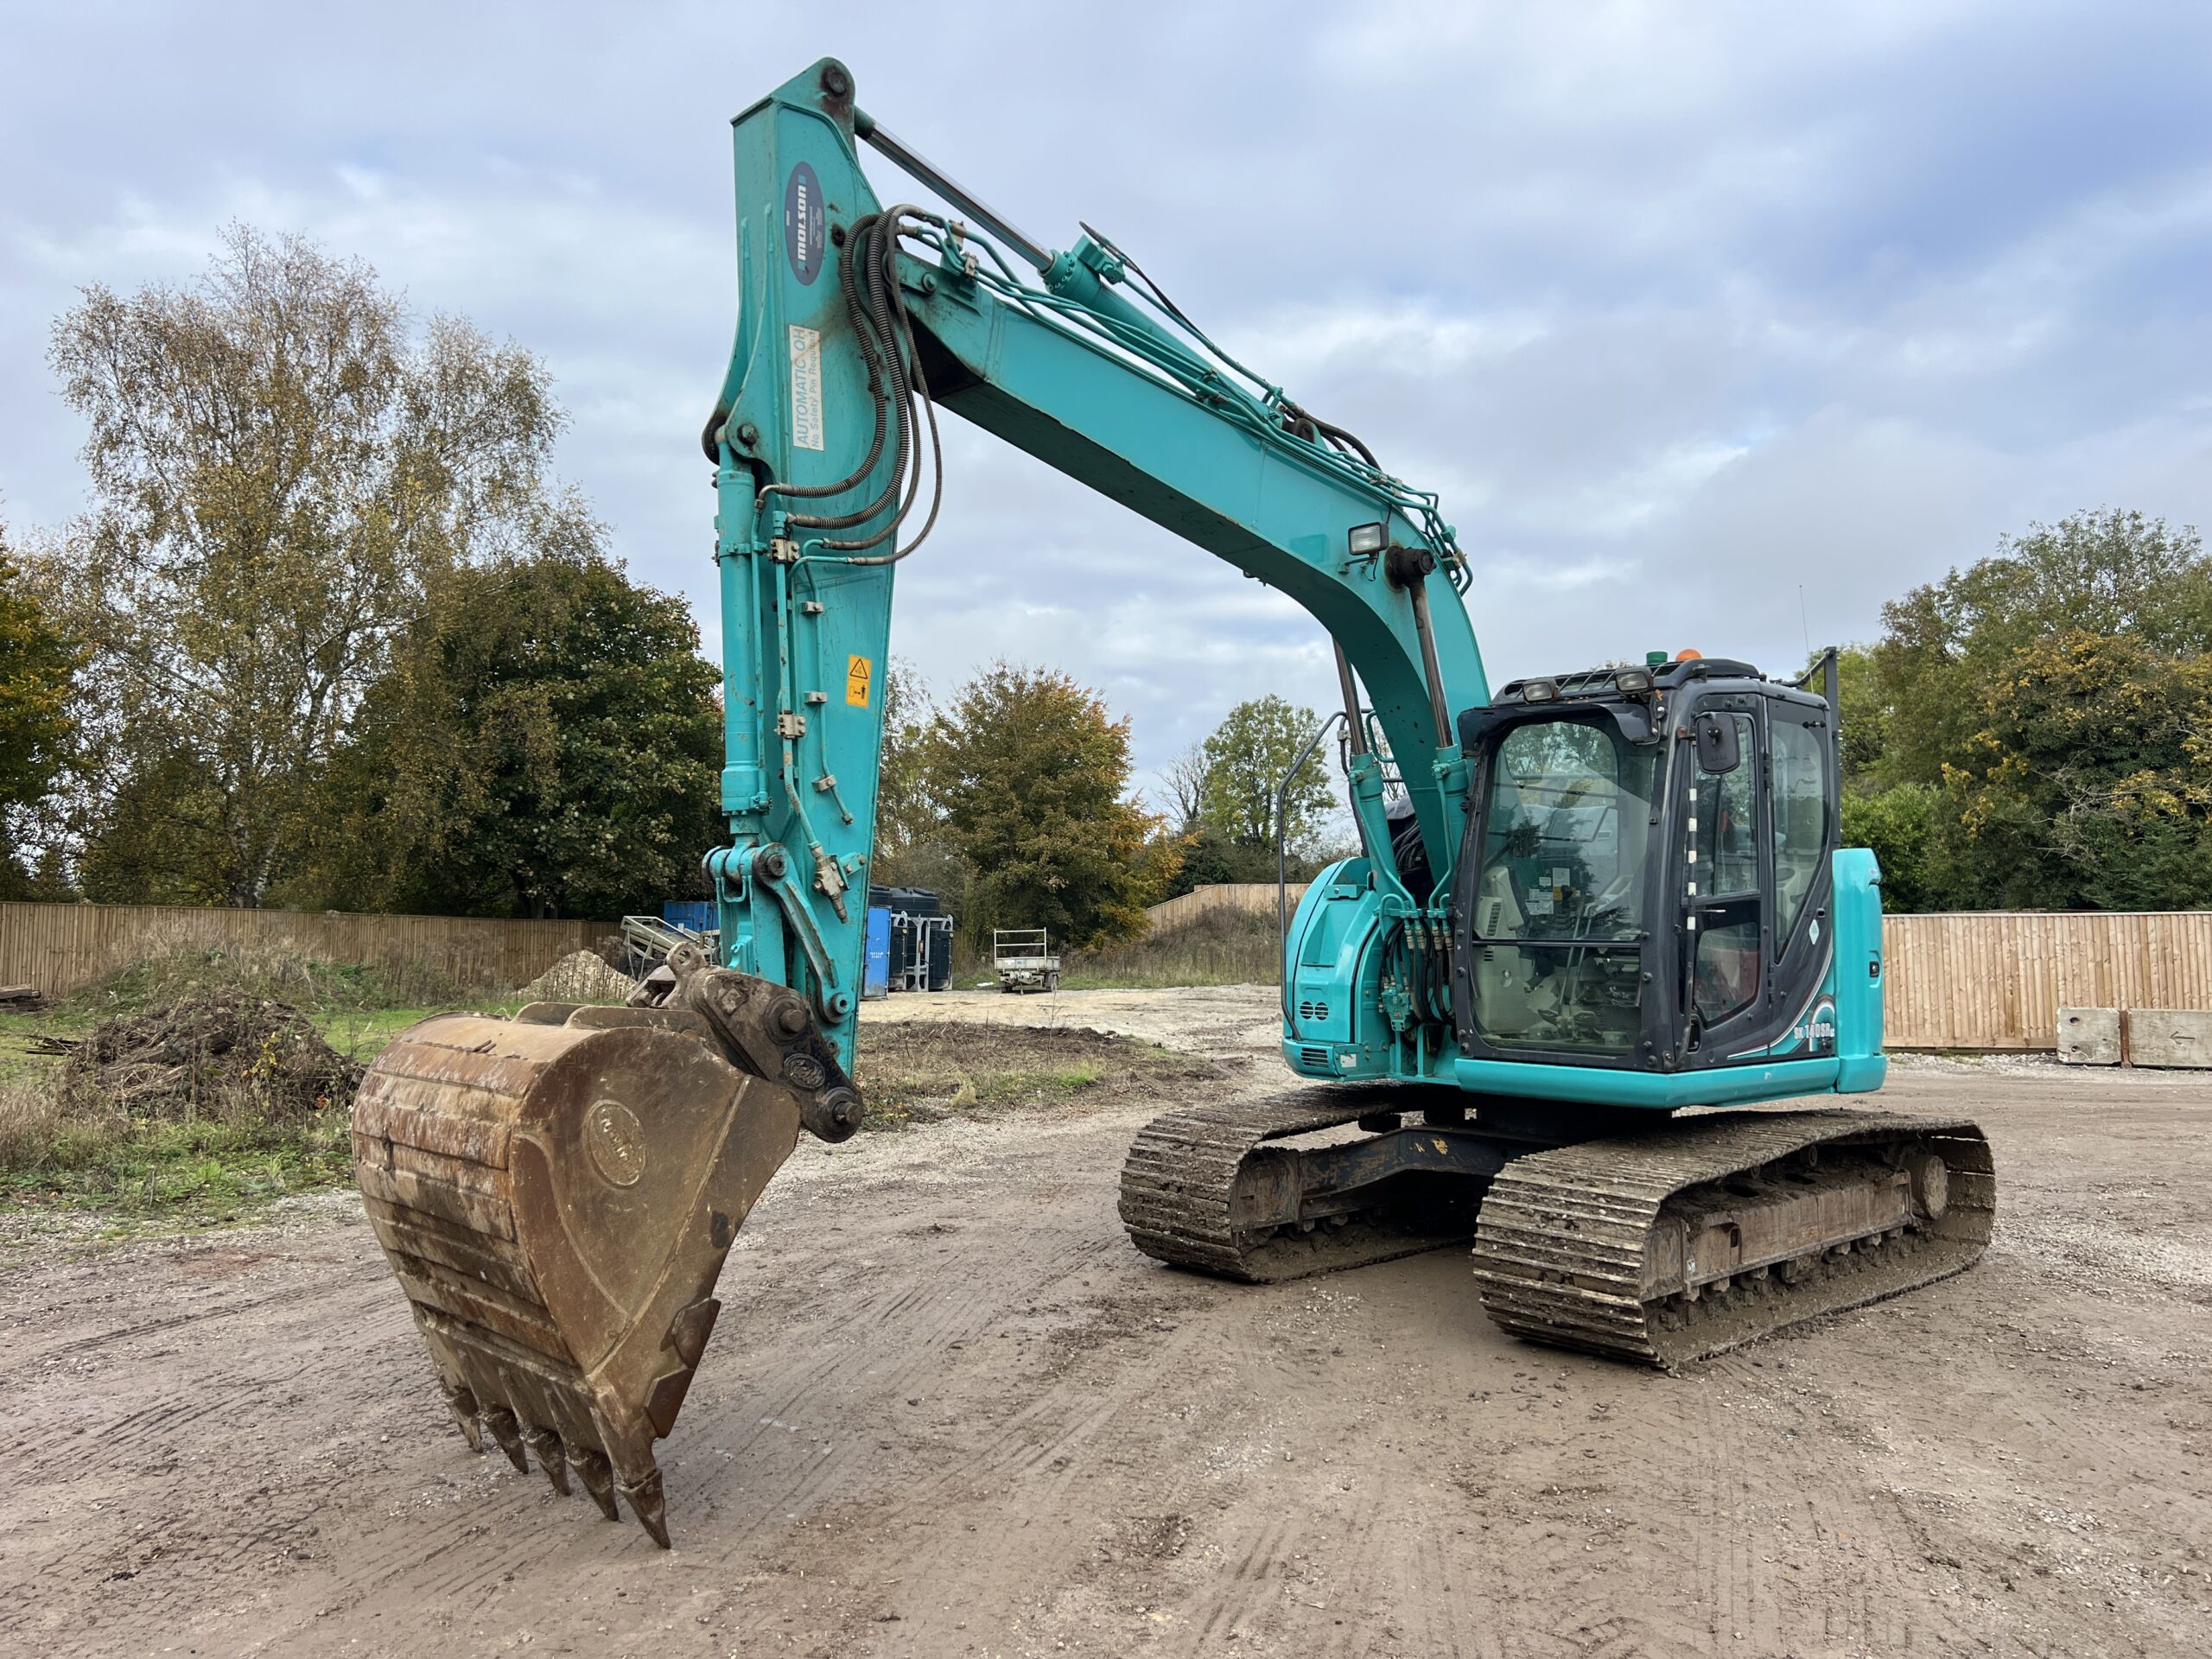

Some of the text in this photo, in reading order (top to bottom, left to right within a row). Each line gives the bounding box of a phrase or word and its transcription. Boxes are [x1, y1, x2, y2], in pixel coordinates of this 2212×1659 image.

[793, 328, 810, 445] AUTOMATIC QH
[808, 331, 820, 448] No Safety Pin Required
